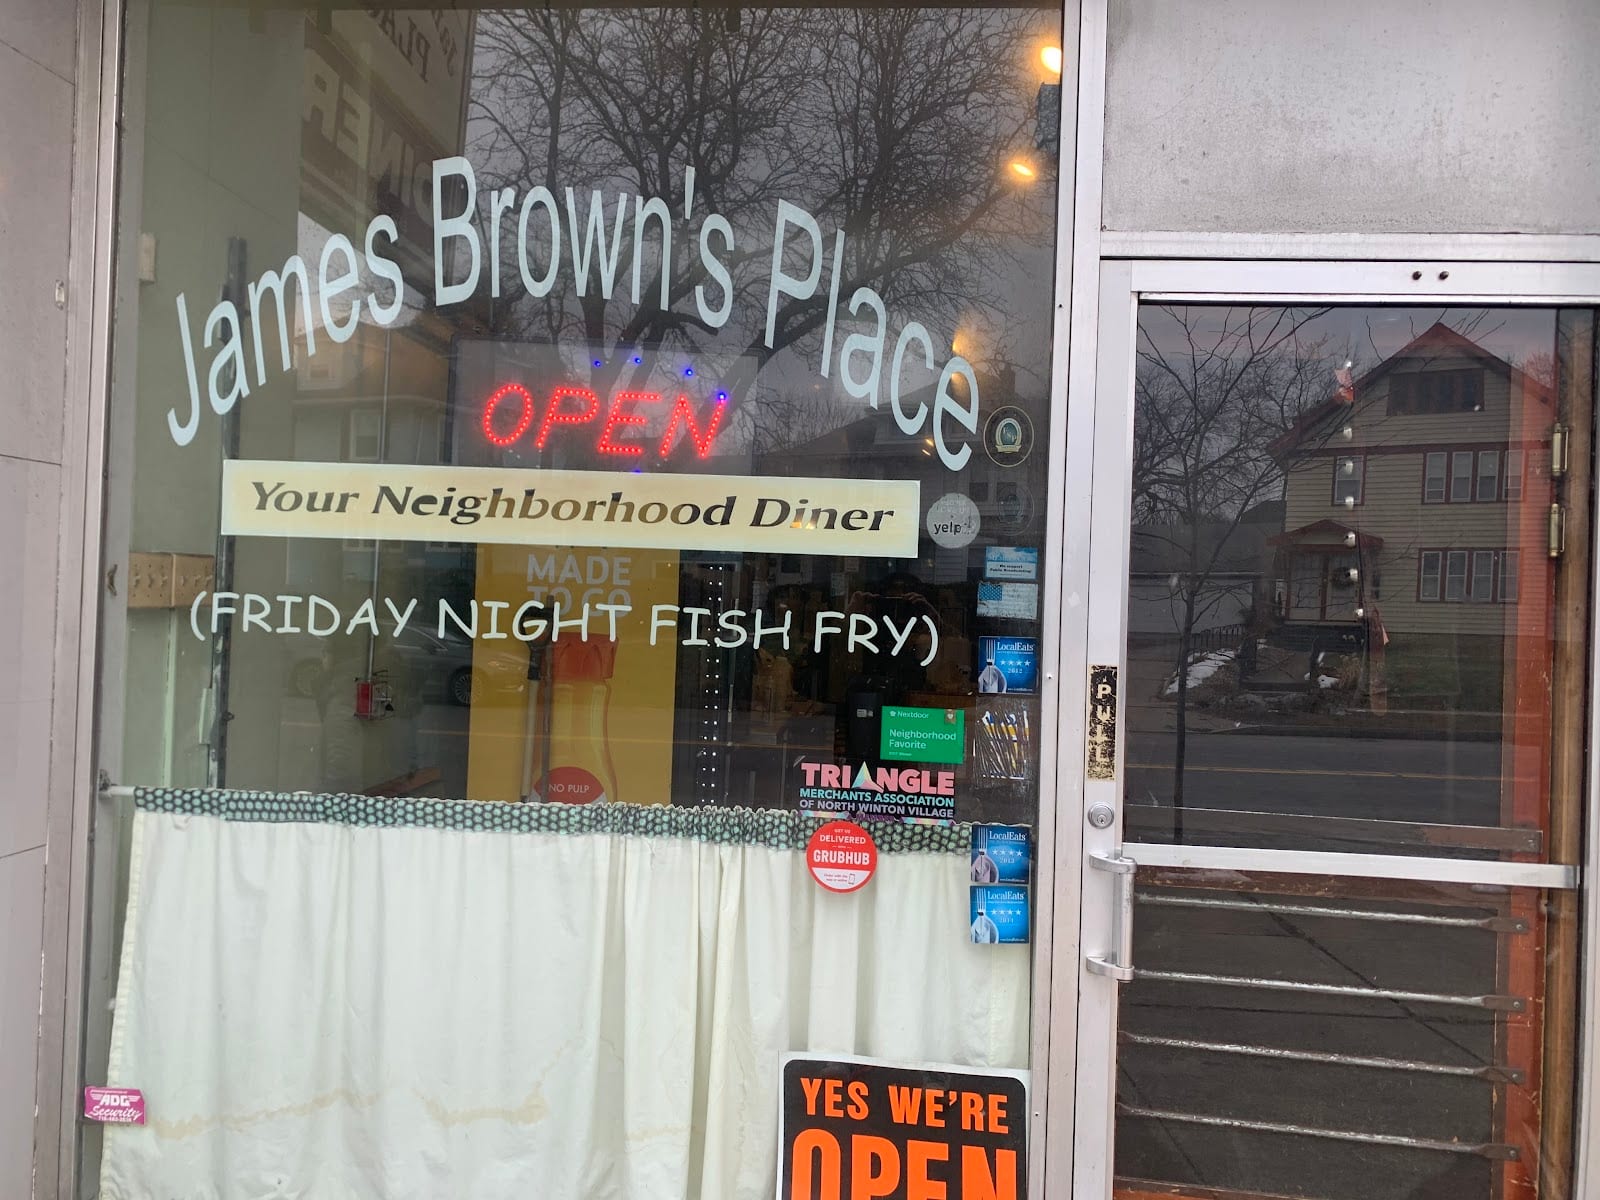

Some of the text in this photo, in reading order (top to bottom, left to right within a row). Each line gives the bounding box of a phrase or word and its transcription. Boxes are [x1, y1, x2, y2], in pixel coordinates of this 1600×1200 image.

[168, 155, 980, 471] James Brown's Place
[481, 382, 726, 458] OPEN
[251, 481, 360, 513] Your
[371, 485, 737, 526] Neighborhood
[749, 497, 895, 532] Diner
[934, 521, 962, 536] yelp
[526, 553, 632, 586] MADE
[190, 591, 939, 667] (FRIDAY NIGHT FISH FRY)
[996, 641, 1034, 652] LocalEats
[897, 710, 929, 719] Nextdoor
[889, 729, 957, 741] Neighborhood
[889, 739, 927, 749] Favorite
[801, 761, 955, 795] TRIANGLE
[548, 783, 590, 793] NO PULP
[799, 788, 955, 807] MERCHANTS ASSOCIATION
[799, 799, 817, 809] OF
[817, 801, 856, 812] NORTH
[858, 803, 906, 815] WINTON
[908, 806, 954, 818] VILLAGE
[819, 834, 867, 845] DELIVERED
[989, 830, 1026, 841] LocalEats
[813, 849, 870, 866] GRUBHUB
[987, 890, 1025, 901] LocalEats
[88, 1105, 143, 1121] Security
[800, 1077, 1009, 1135] YES WE'RE
[791, 1128, 1017, 1200] OPEN
